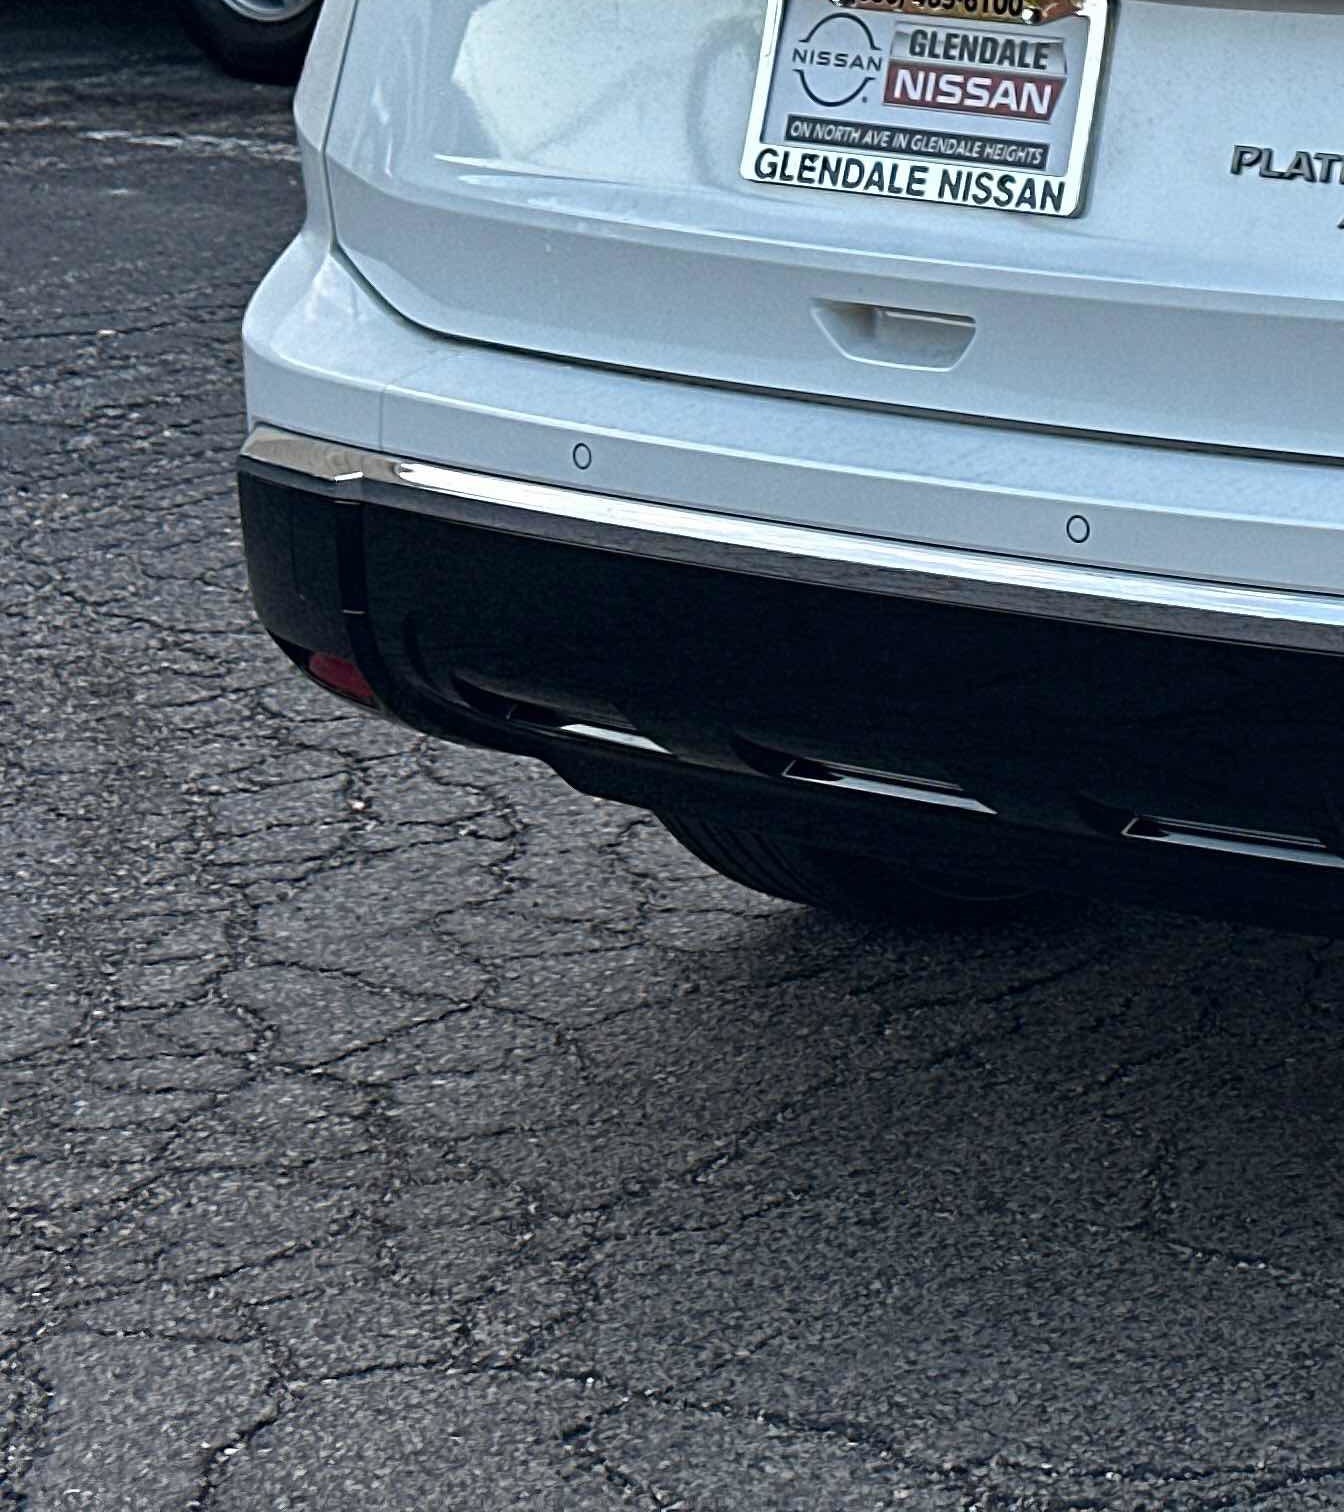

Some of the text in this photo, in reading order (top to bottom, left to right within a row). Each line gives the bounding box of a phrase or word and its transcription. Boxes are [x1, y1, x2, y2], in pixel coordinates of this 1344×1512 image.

[791, 46, 883, 73] NISSAN
[908, 28, 1049, 71] GLENDALE
[893, 70, 1053, 116] NISSAN
[790, 121, 1045, 166] ON NORTH AVE IN GLENDALE HEIGHTS
[753, 147, 1066, 214] GLENDALE NISSAN
